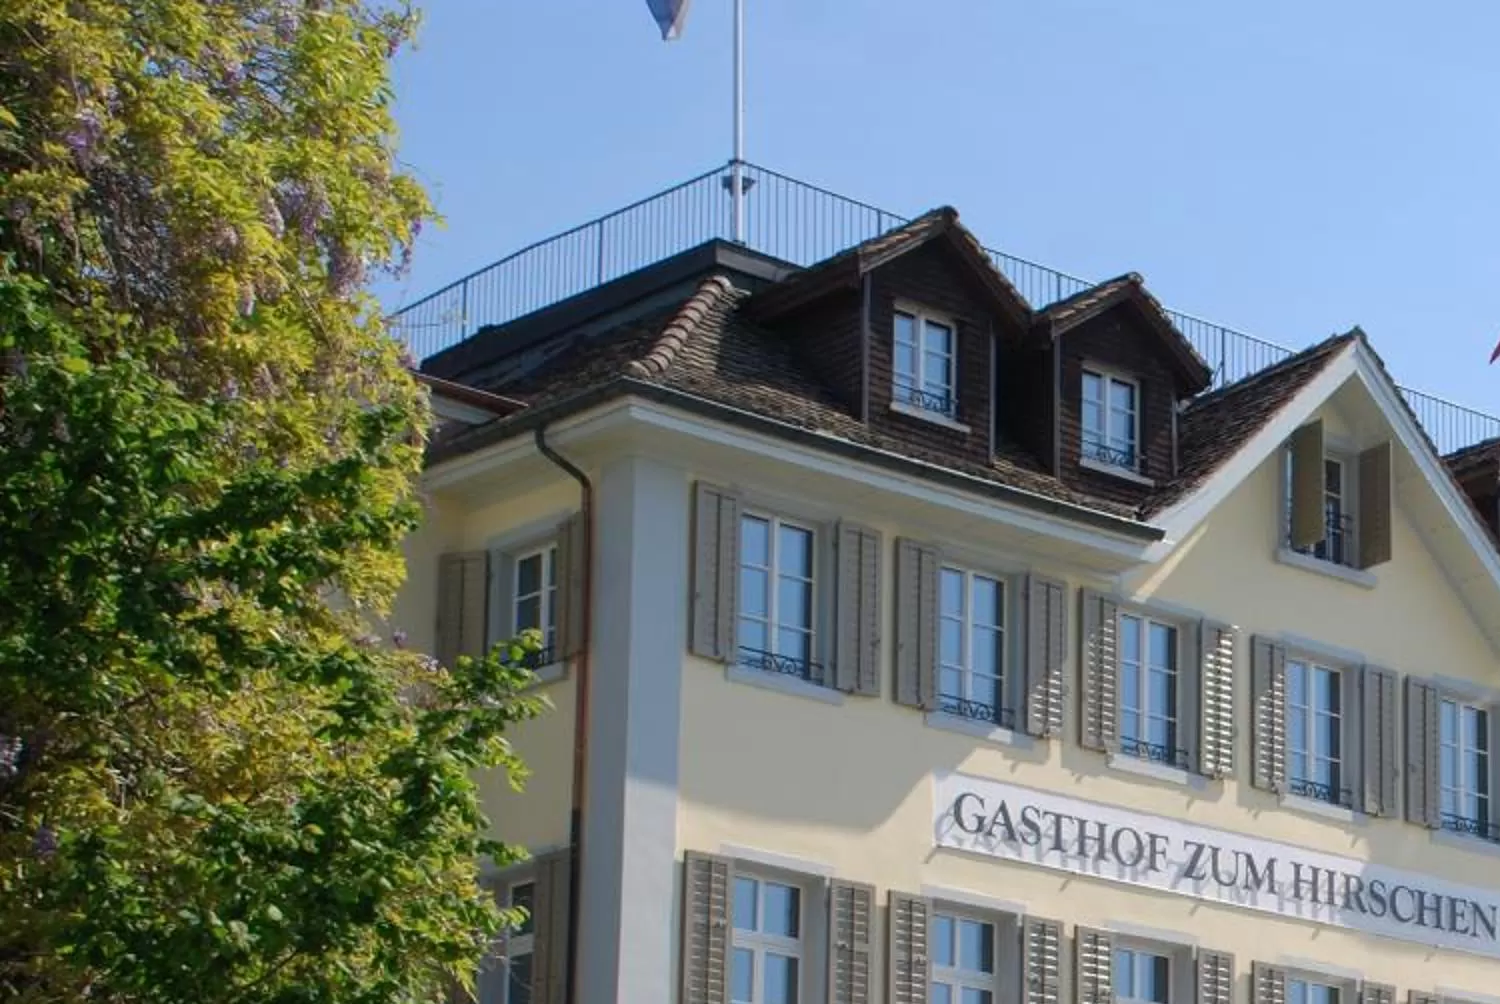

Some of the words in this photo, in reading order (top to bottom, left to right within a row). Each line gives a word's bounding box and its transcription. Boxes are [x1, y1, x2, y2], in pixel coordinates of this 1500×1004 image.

[953, 792, 1169, 871] GASTHOF
[1183, 840, 1277, 895] ZUM
[1290, 861, 1497, 940] HIRSCHEN
